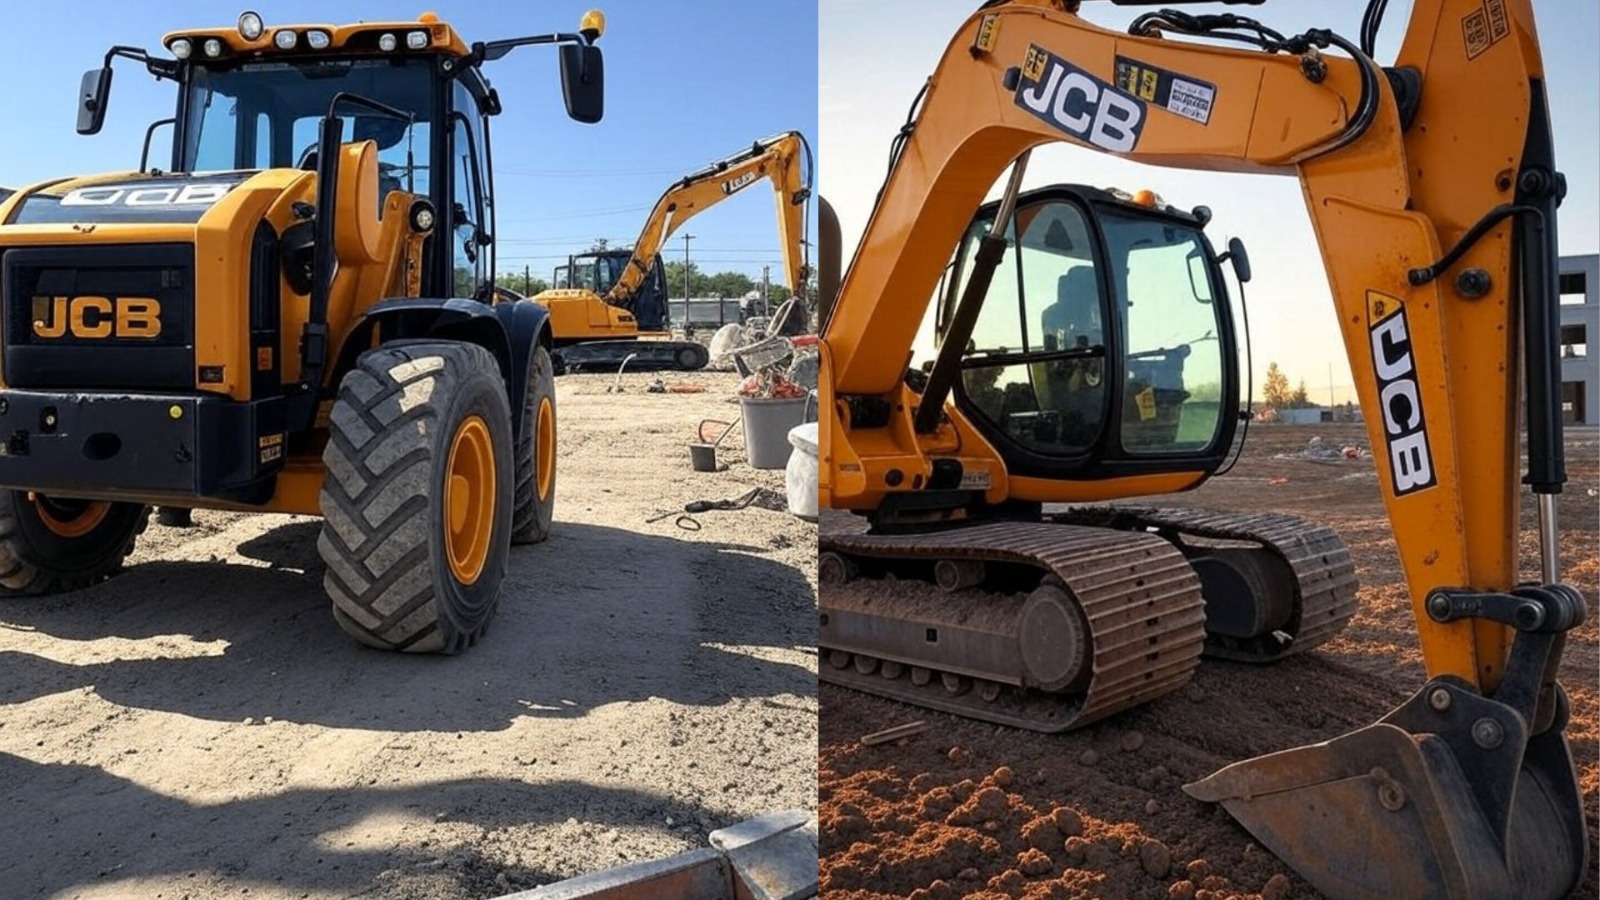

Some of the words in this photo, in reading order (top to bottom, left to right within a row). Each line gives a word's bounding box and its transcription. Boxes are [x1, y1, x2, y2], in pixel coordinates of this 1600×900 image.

[1023, 62, 1141, 152] JCB
[32, 296, 161, 338] JCB
[1371, 311, 1431, 491] JCB
